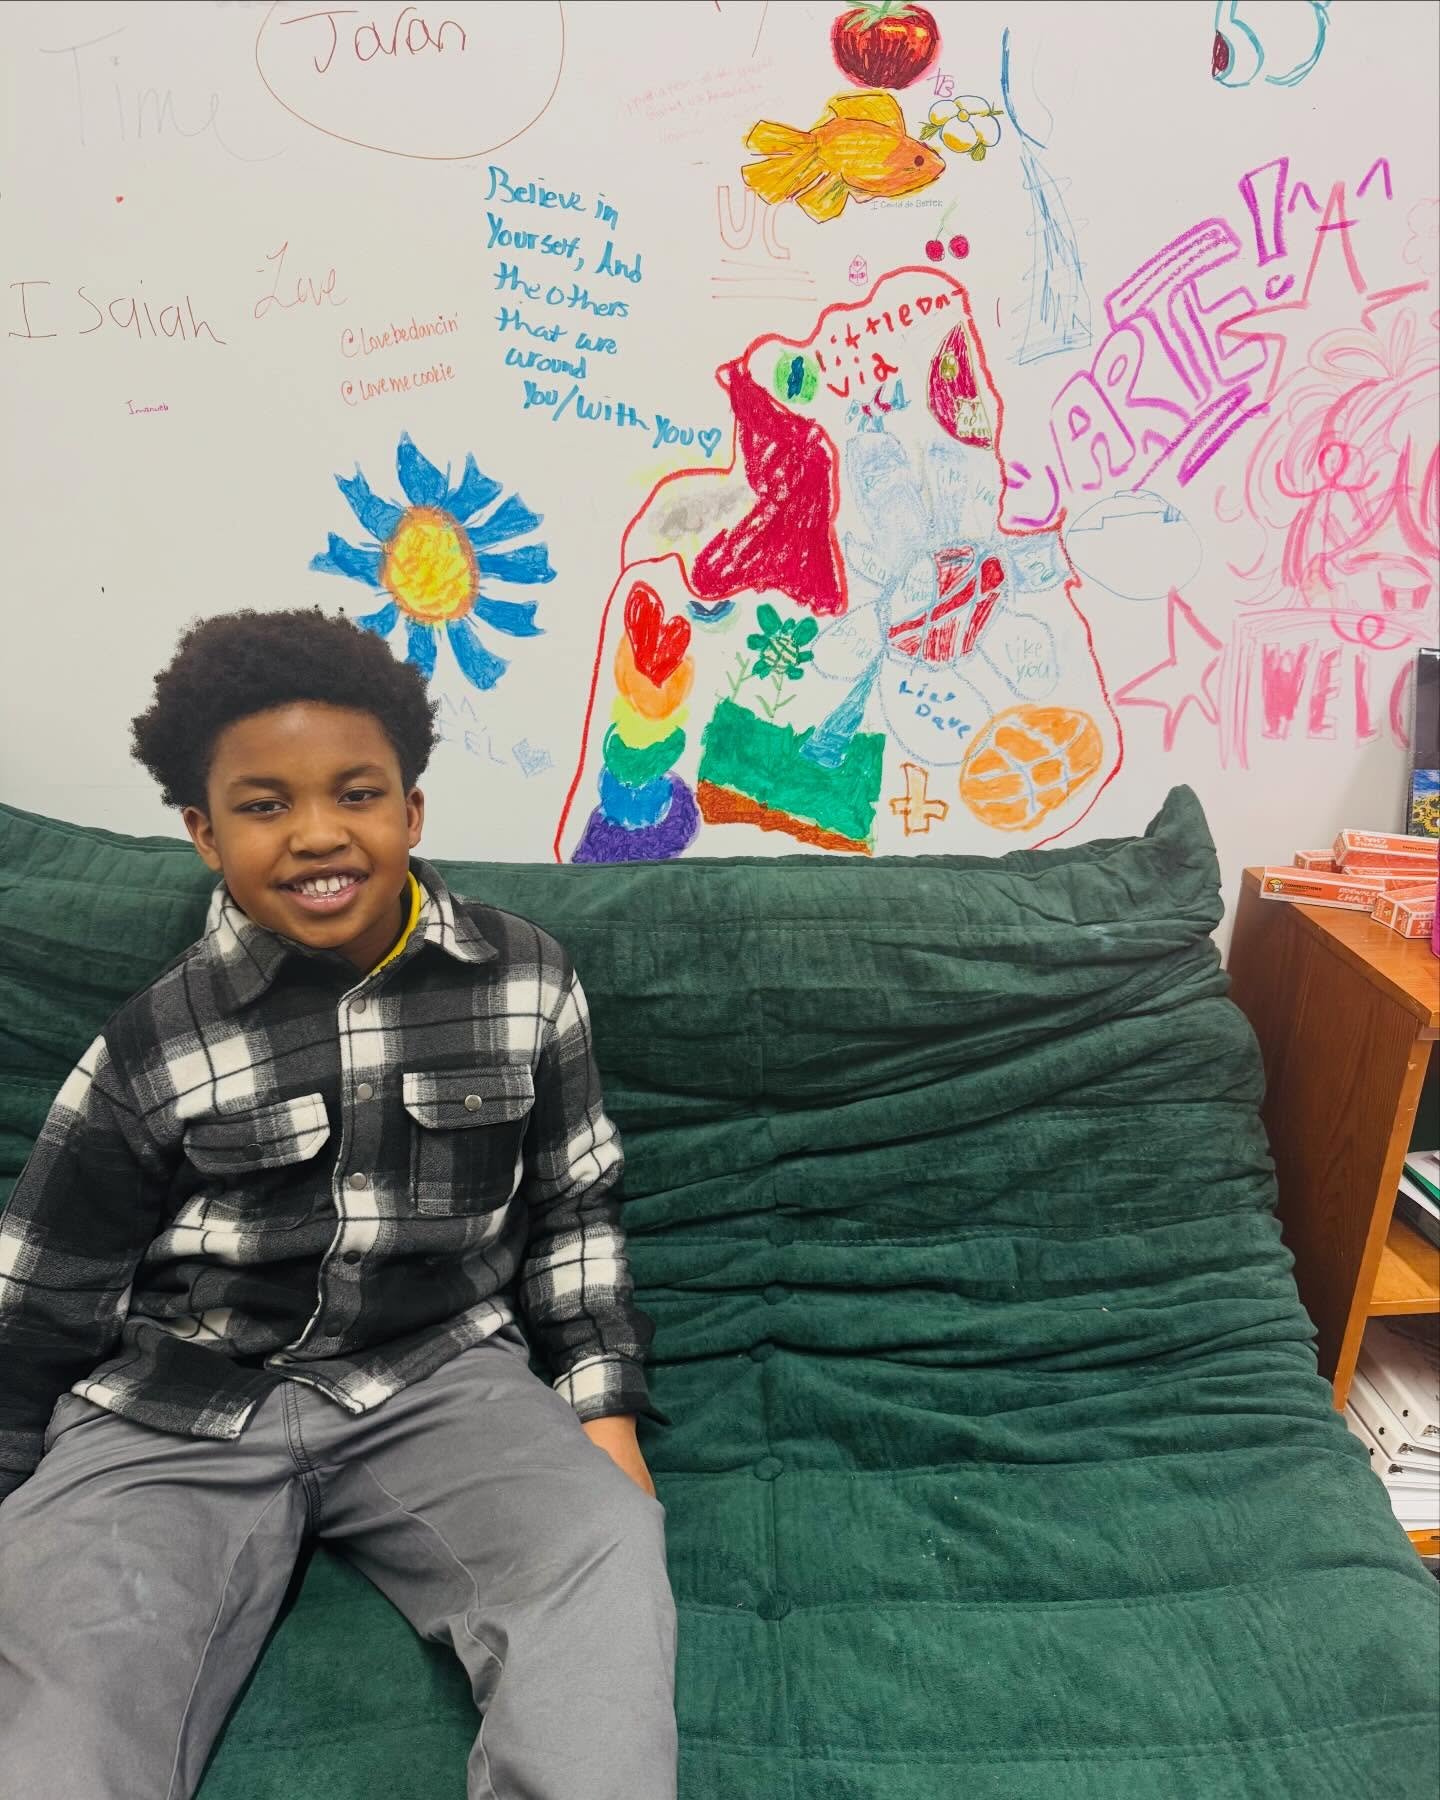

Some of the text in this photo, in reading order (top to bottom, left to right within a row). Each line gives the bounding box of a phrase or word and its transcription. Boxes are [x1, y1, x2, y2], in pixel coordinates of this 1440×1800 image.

[484, 165, 620, 231] Believe in
[594, 240, 643, 284] And
[494, 305, 568, 343] that
[504, 347, 587, 380] around
[651, 413, 696, 450] You
